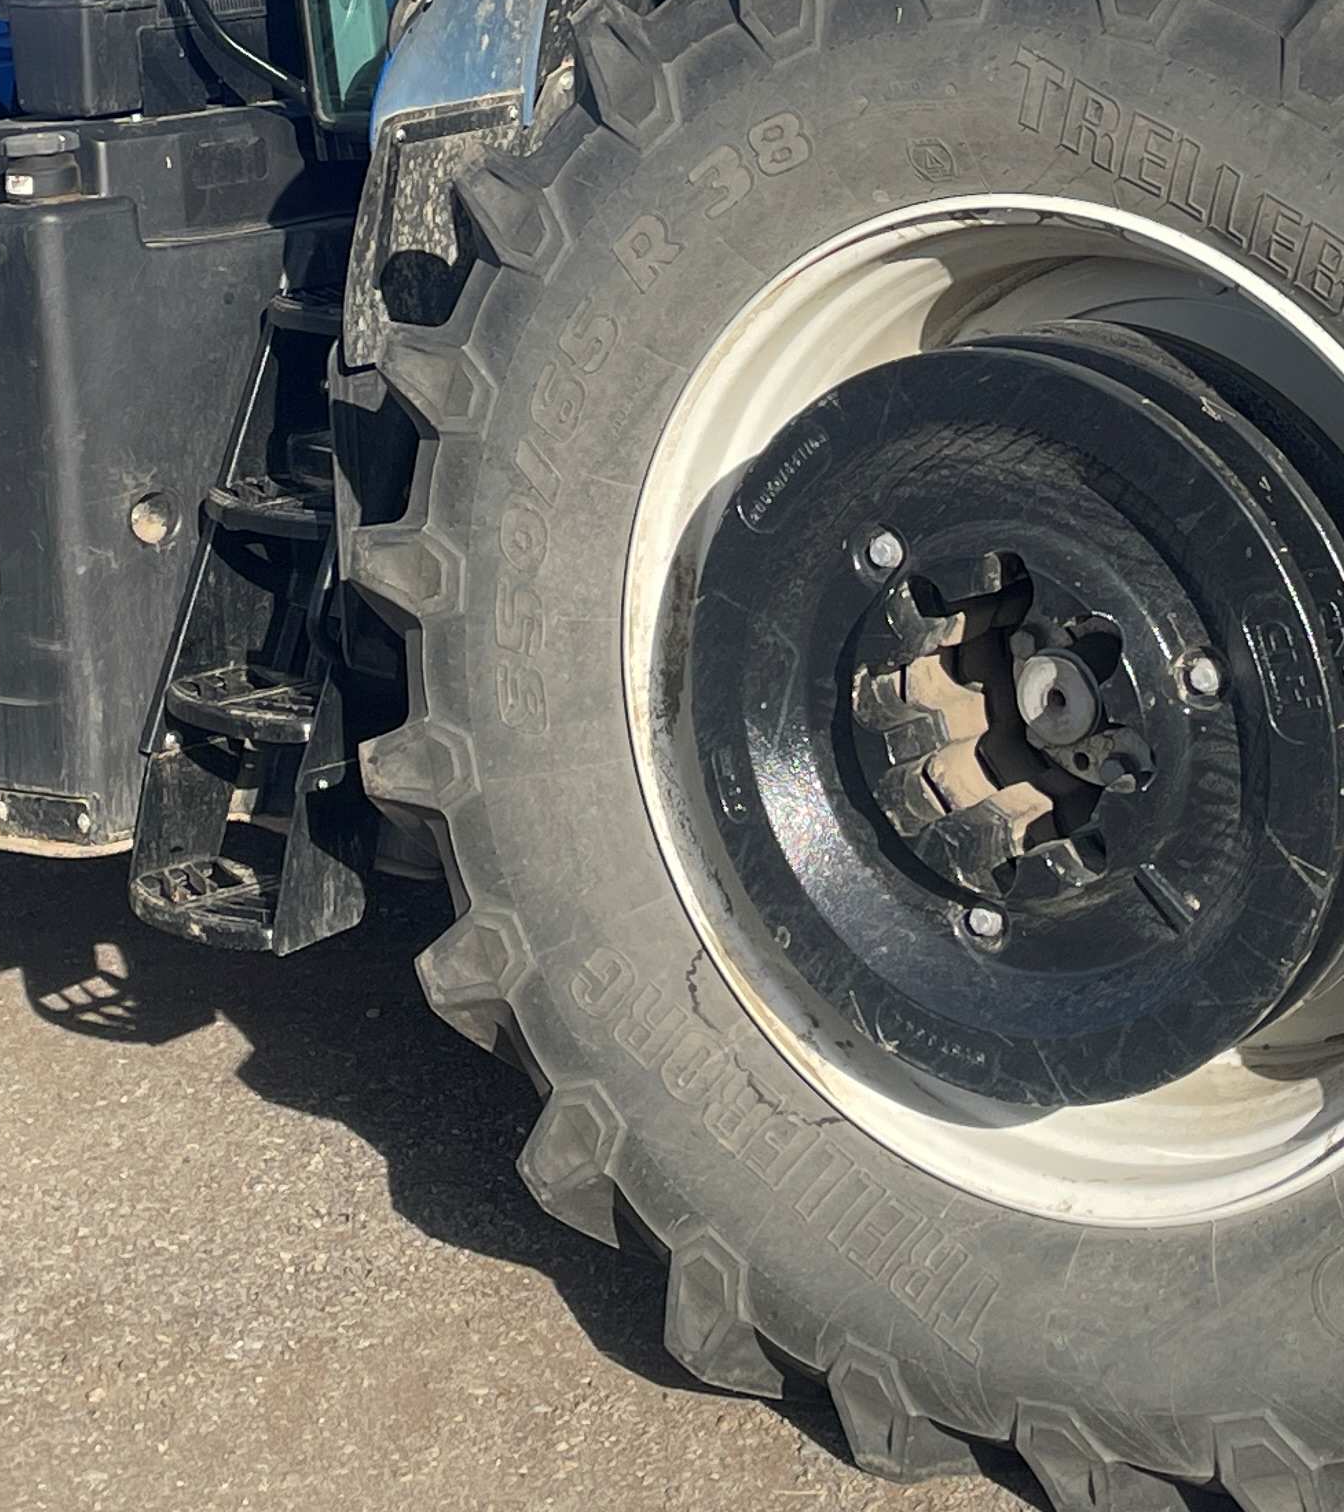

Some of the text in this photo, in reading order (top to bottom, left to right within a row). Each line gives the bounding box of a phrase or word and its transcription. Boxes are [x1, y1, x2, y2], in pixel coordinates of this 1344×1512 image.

[609, 214, 685, 294] R
[685, 108, 815, 220] 38
[569, 945, 1000, 1366] TRELLEBORG
